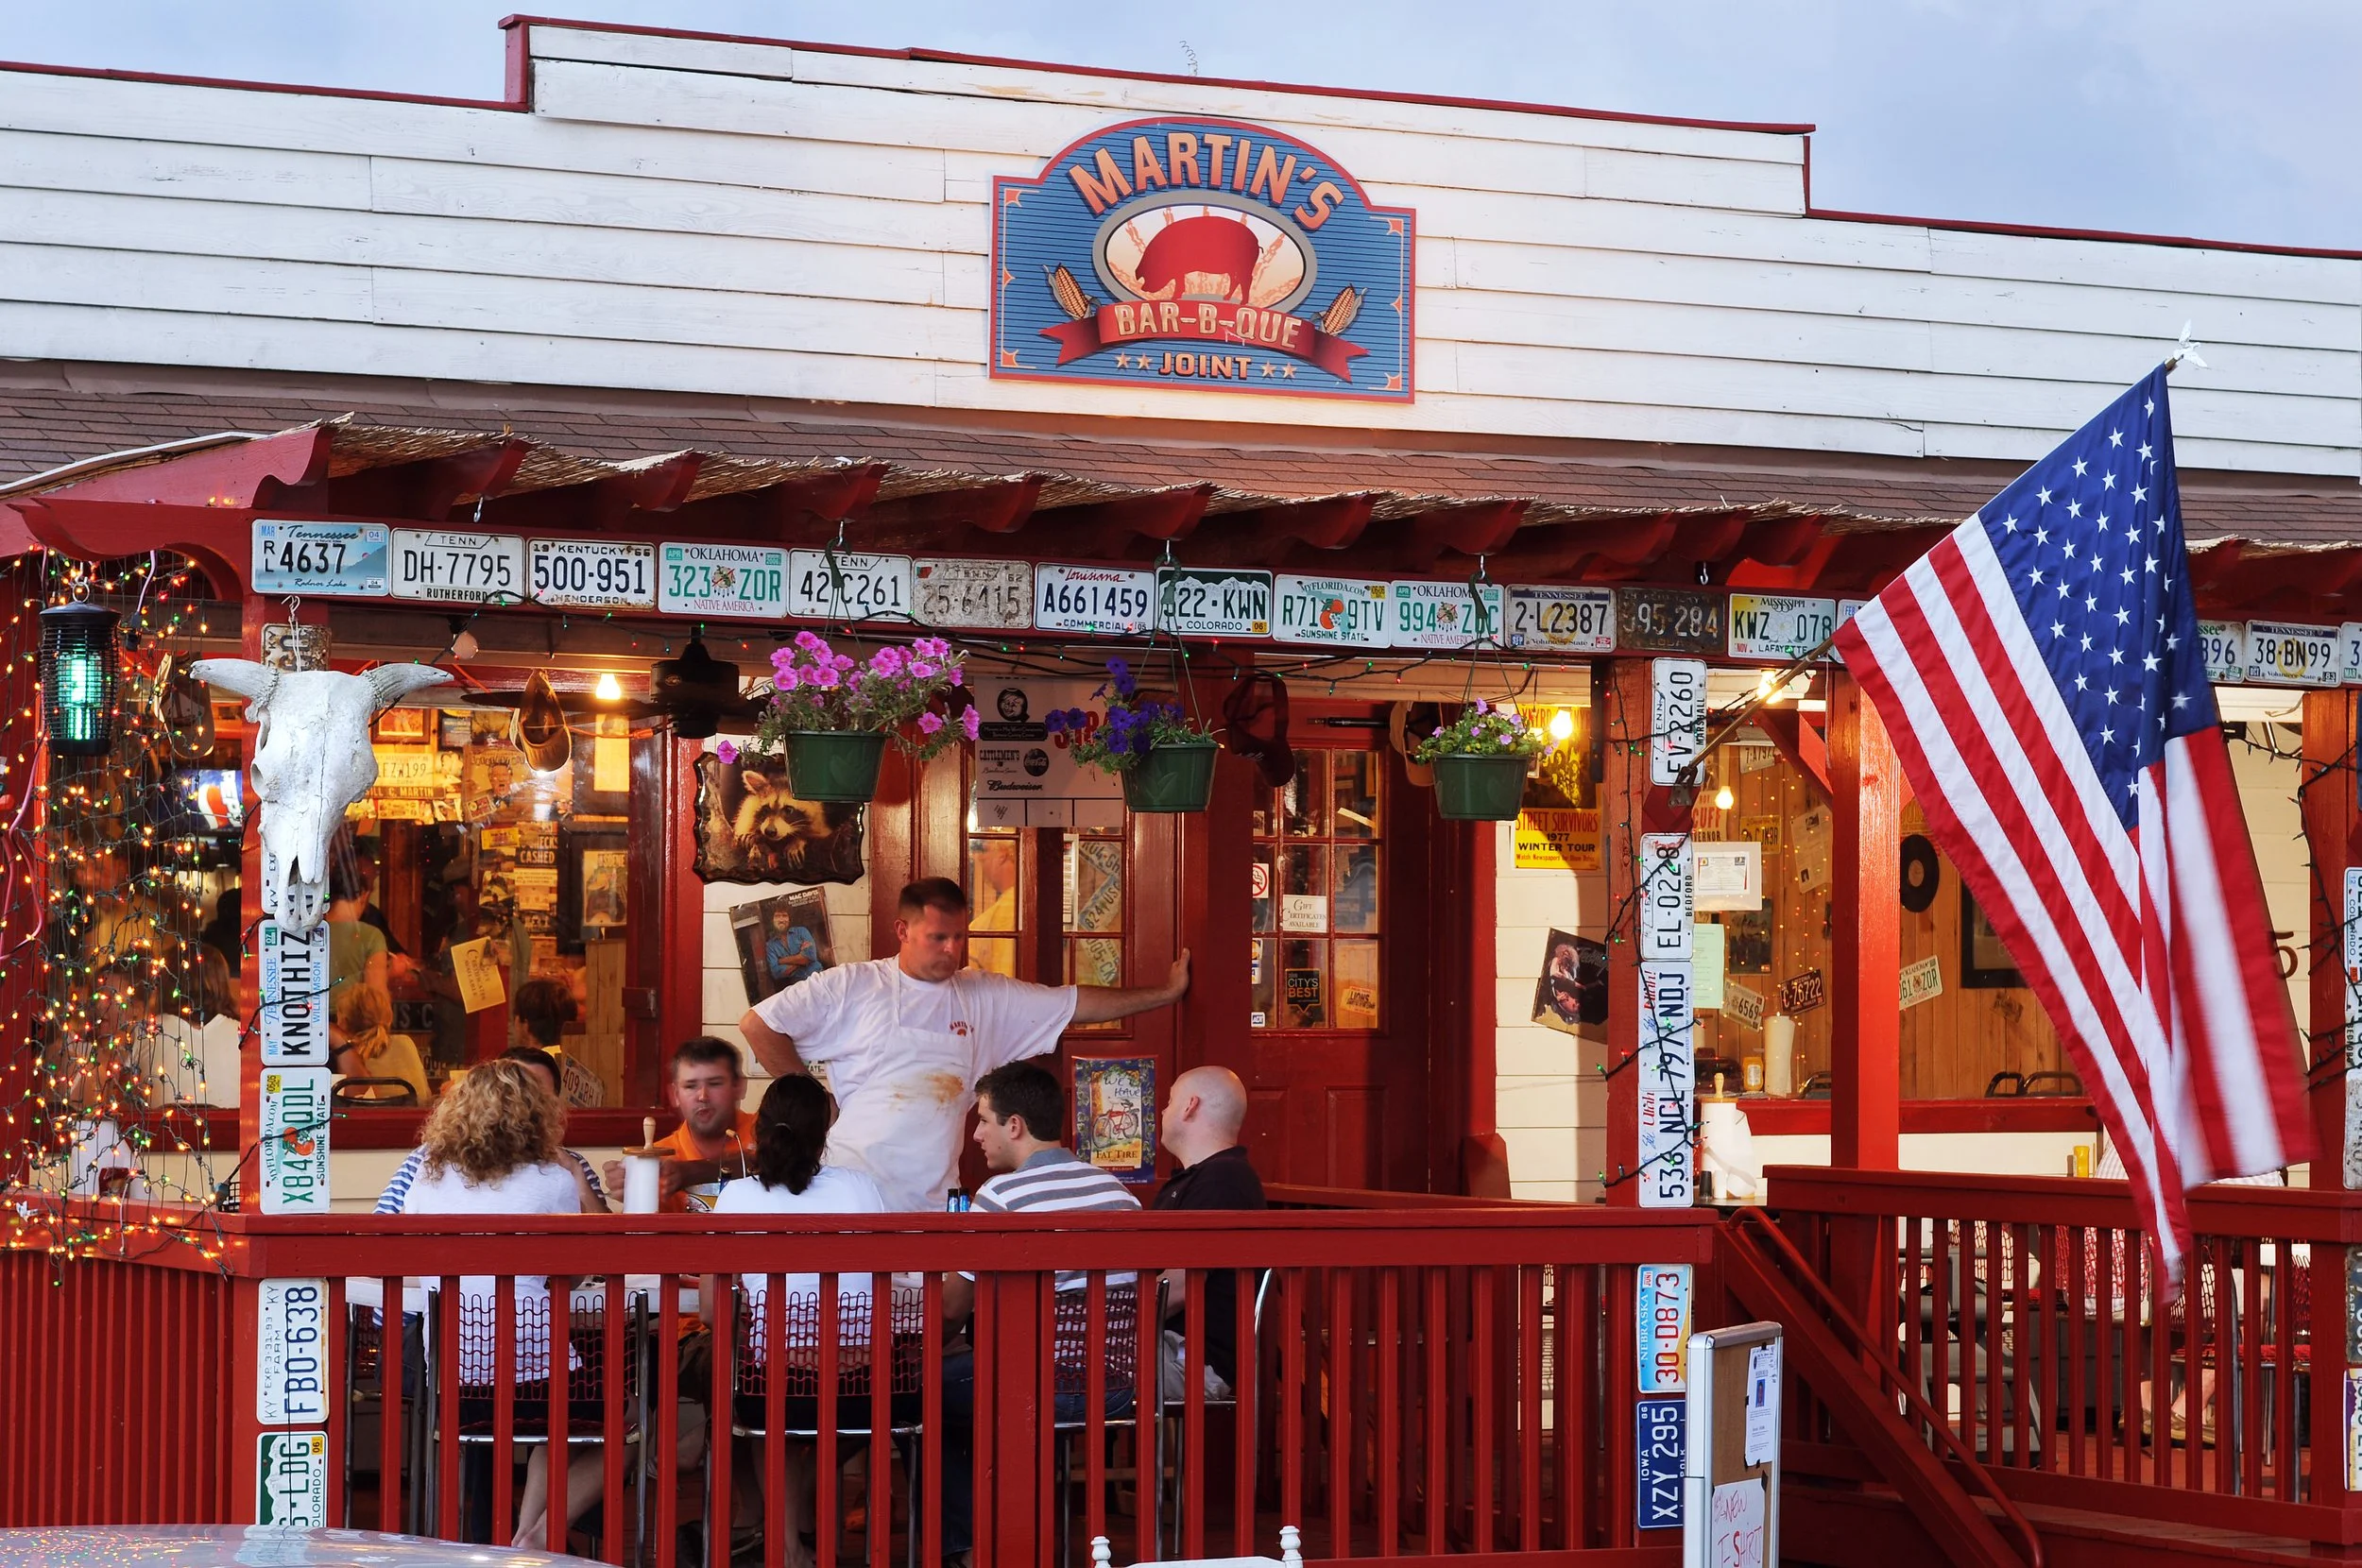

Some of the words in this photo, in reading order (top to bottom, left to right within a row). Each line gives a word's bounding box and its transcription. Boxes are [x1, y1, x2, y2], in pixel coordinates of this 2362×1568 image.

[1068, 131, 1345, 232] MARTIN'S
[1113, 300, 1303, 349] BAR-B-QUE
[1158, 350, 1253, 380] JOINT
[287, 524, 358, 539] Tennessee
[439, 535, 477, 546] TENN
[280, 541, 346, 574] 4637
[557, 544, 625, 555] KENTUCKY
[690, 547, 759, 563] OKLAHOMA
[403, 550, 510, 587] DH-7795
[534, 554, 646, 594] 500-951
[669, 564, 710, 598] 323
[1065, 569, 1126, 582] Louisiana
[426, 588, 488, 601] RUTHERFORD
[693, 599, 720, 610] NATIVE
[722, 600, 755, 613] AMERICA
[1043, 583, 1148, 619] A661459
[1417, 585, 1474, 598] OKLAHOM
[1532, 591, 1586, 600] TENNESSEE
[1759, 597, 1806, 612] MISSISSIPPI
[1186, 621, 1242, 631] COLORADO
[1282, 594, 1318, 627] R71
[1347, 599, 1384, 631] 9TV
[1399, 602, 1436, 633] 994
[1515, 601, 1607, 636] 2-L2387
[1735, 610, 1771, 640] KWZ
[1300, 628, 1338, 640] SUNSHINE
[1341, 631, 1364, 641] STATE
[2270, 626, 2315, 636] TENNESSEE
[1758, 644, 1808, 654] LAFAYTTE
[2254, 637, 2332, 669] 38-BN99
[1696, 698, 1705, 746] MARSHALL
[400, 787, 435, 797] MARTIN
[987, 779, 1043, 792] Budweiser
[1515, 811, 1549, 831] STREET
[1552, 811, 1599, 833] SURVIVORS
[1547, 832, 1570, 842] 1977
[520, 850, 556, 864] CASHED
[1517, 843, 1563, 851] WINTER
[1566, 843, 1596, 852] TOUR
[1685, 875, 1693, 917] BEDFORD
[265, 957, 281, 1025] TENNESSEE
[1287, 978, 1319, 988] CITY'S
[1288, 987, 1318, 998] BEST
[1658, 972, 1686, 1017] NDJ
[317, 1133, 326, 1180] SUNSHINE
[1096, 1150, 1113, 1159] FAT
[1114, 1150, 1138, 1158] TIRE
[282, 1159, 314, 1204] X84
[1640, 1293, 1649, 1361] NEBRASKA
[1654, 1272, 1680, 1384] 30-D873
[1651, 1406, 1679, 1458] 295
[1641, 1448, 1650, 1481] IOWA
[312, 1468, 322, 1527] OLORADO
[1652, 1469, 1679, 1520] XZY
[1725, 1489, 1748, 1523] NEW
